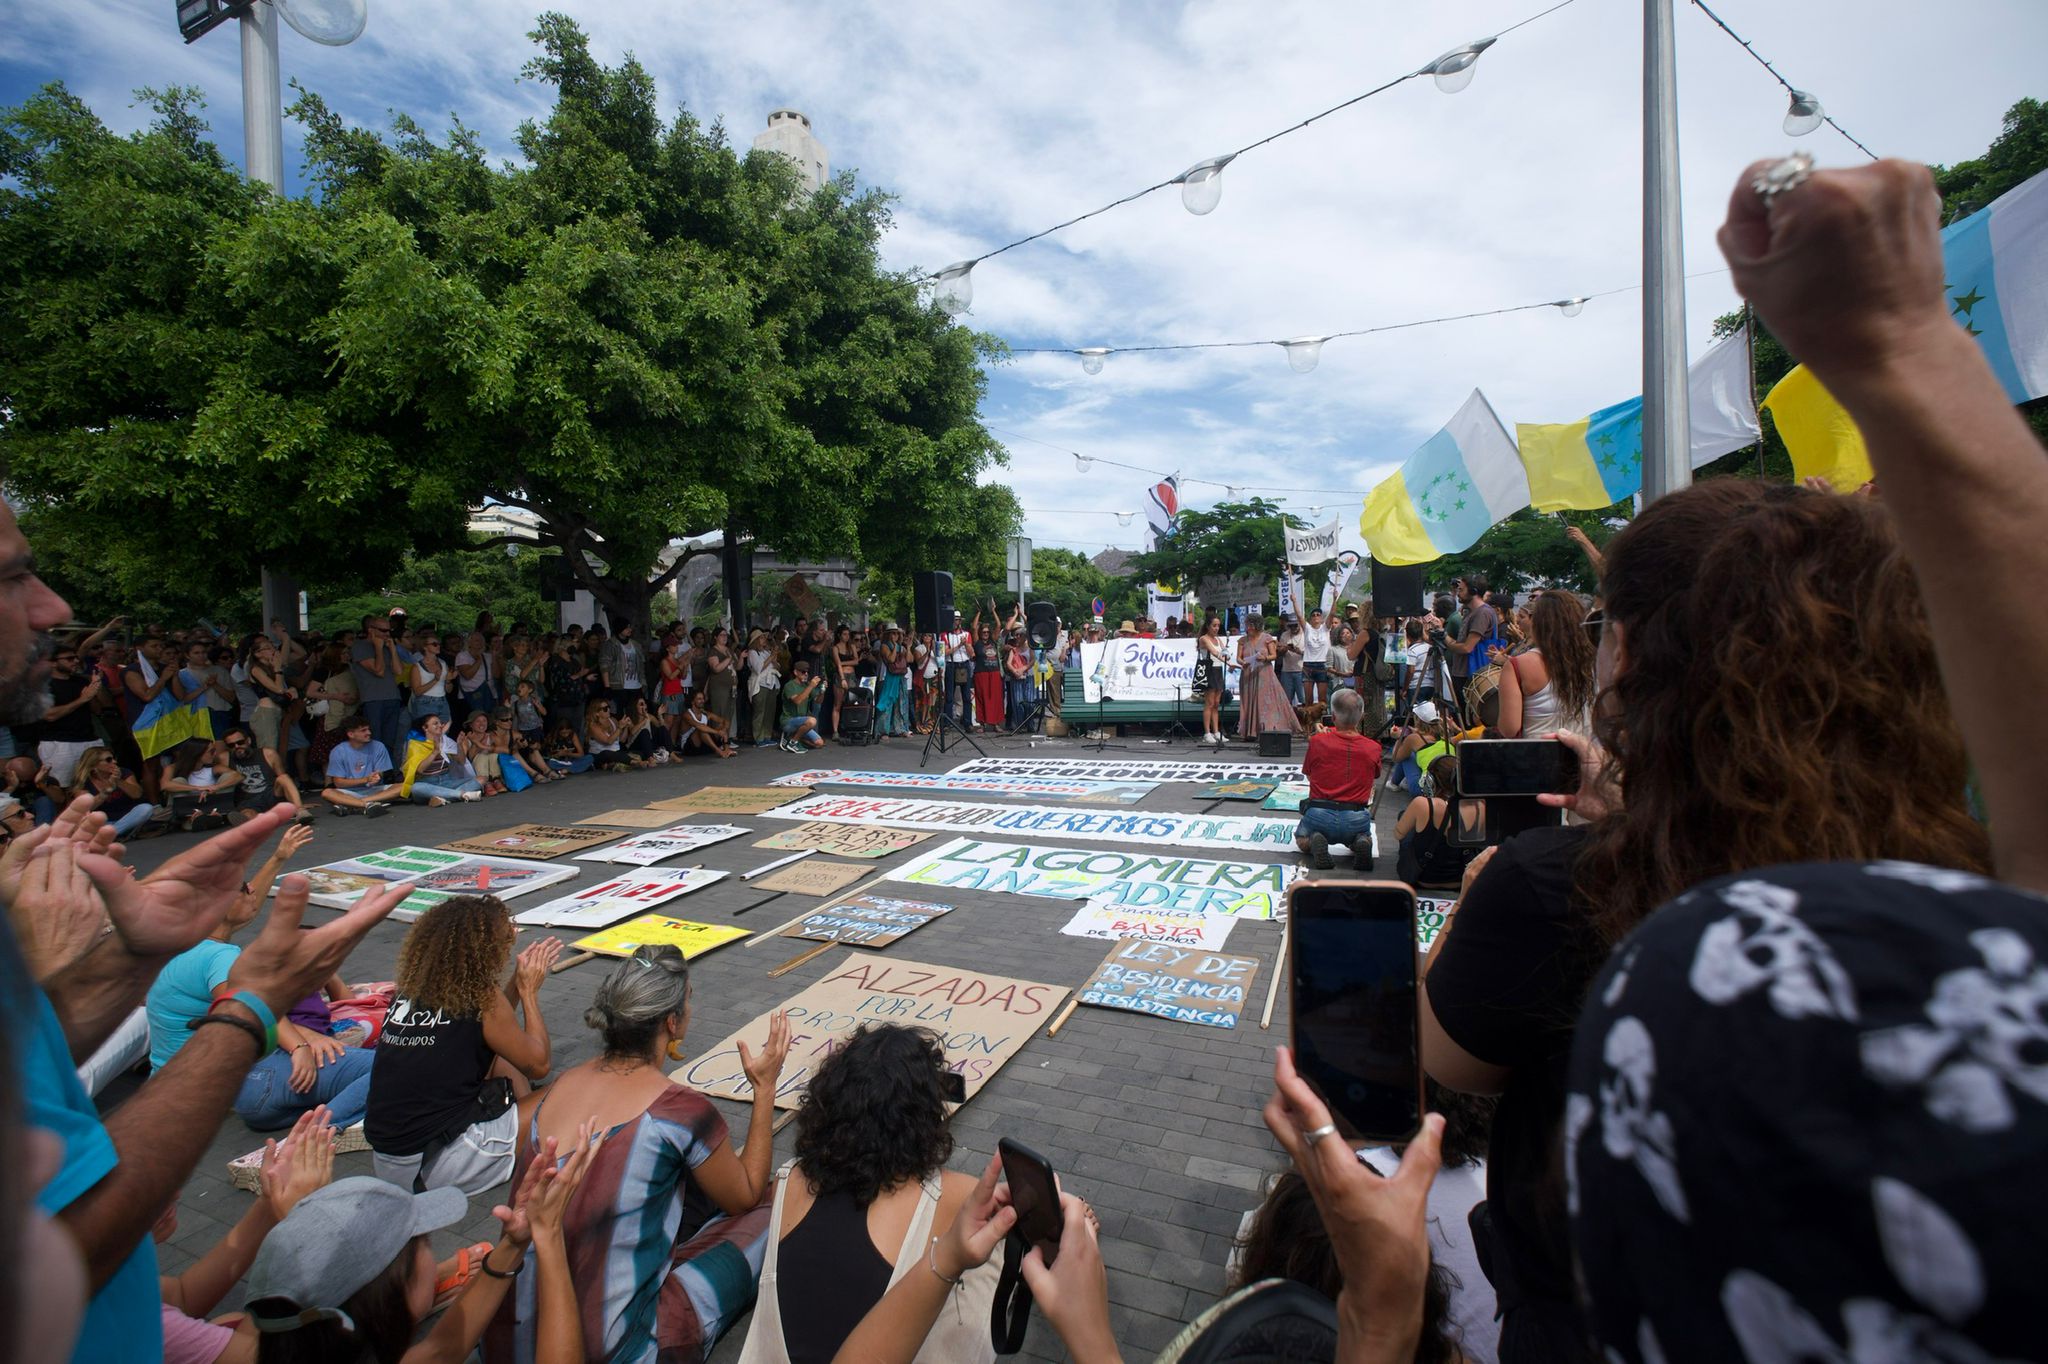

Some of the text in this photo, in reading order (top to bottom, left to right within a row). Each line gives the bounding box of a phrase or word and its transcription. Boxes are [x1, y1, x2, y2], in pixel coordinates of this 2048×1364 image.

[1290, 530, 1335, 552] JEDIONDOS
[1124, 643, 1185, 663] Salvar
[1142, 660, 1196, 680] Canar
[946, 782, 1089, 793] VERTIDOS
[875, 804, 1006, 826] LEGADO
[993, 810, 1182, 837] QUEREMOS
[904, 863, 1273, 919] LANZADERA
[1087, 929, 1108, 937] DE
[1111, 920, 1204, 940] BASTA
[1119, 941, 1260, 981] LEY DE
[822, 964, 1051, 1015] ALZADAS
[856, 995, 953, 1022] POR LA
